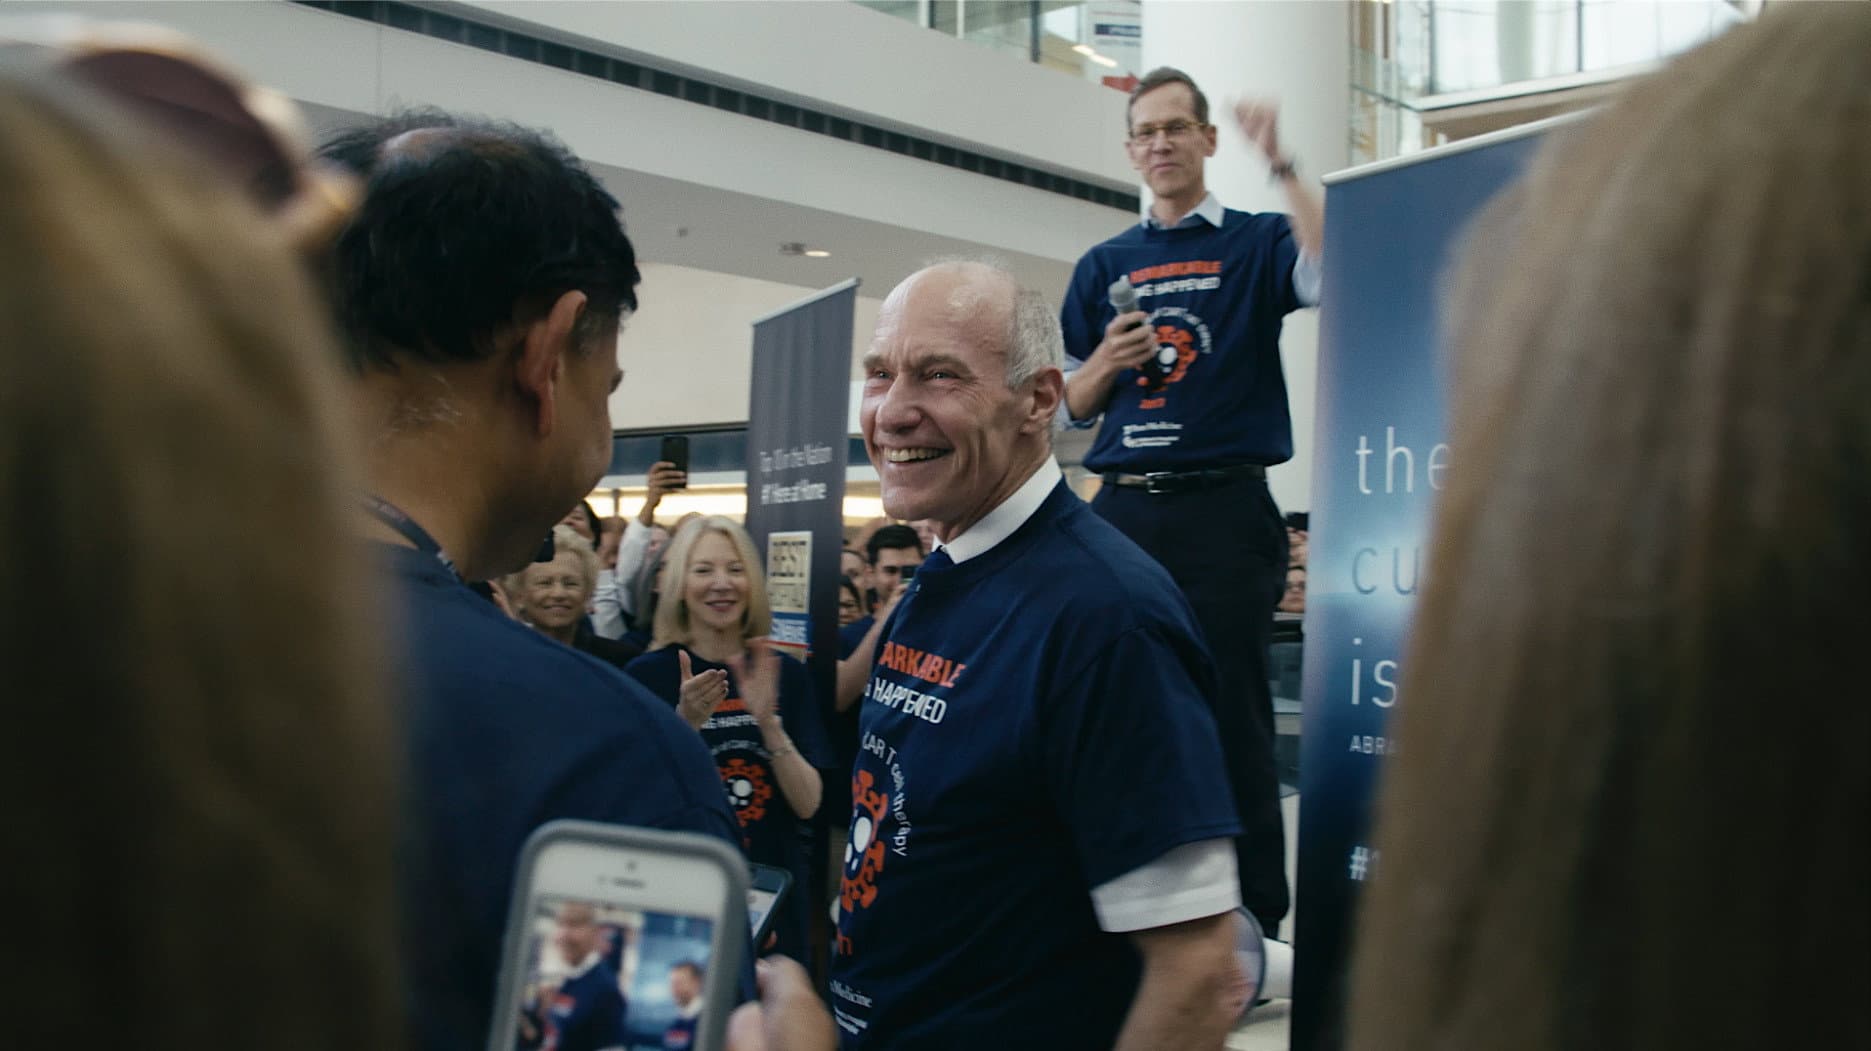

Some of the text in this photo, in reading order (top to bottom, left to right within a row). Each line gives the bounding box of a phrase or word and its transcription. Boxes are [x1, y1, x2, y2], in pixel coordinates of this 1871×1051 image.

[1355, 426, 1452, 495] the
[1352, 547, 1420, 596] cu
[878, 641, 967, 688] ARKABLE
[1351, 638, 1399, 708] is
[872, 677, 947, 724] HAPPENED
